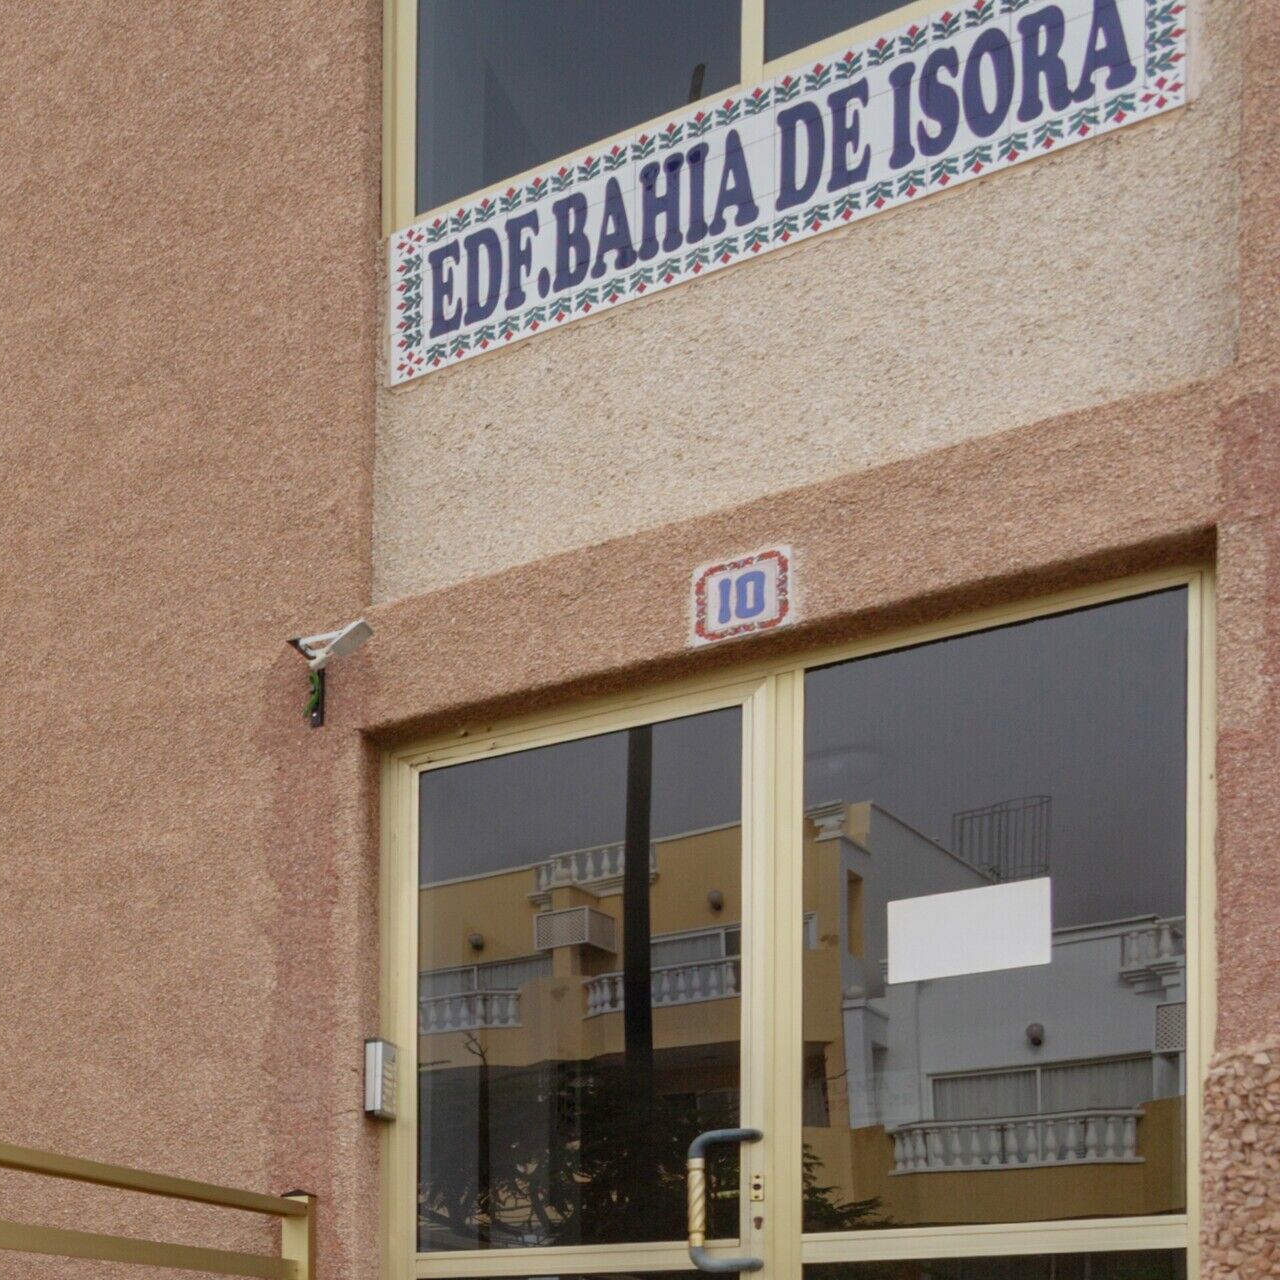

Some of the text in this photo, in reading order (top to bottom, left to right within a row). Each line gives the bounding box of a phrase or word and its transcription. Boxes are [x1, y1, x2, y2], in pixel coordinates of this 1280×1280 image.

[775, 77, 872, 211] DE
[888, 0, 1137, 170] ISORA
[718, 570, 765, 624] 10
